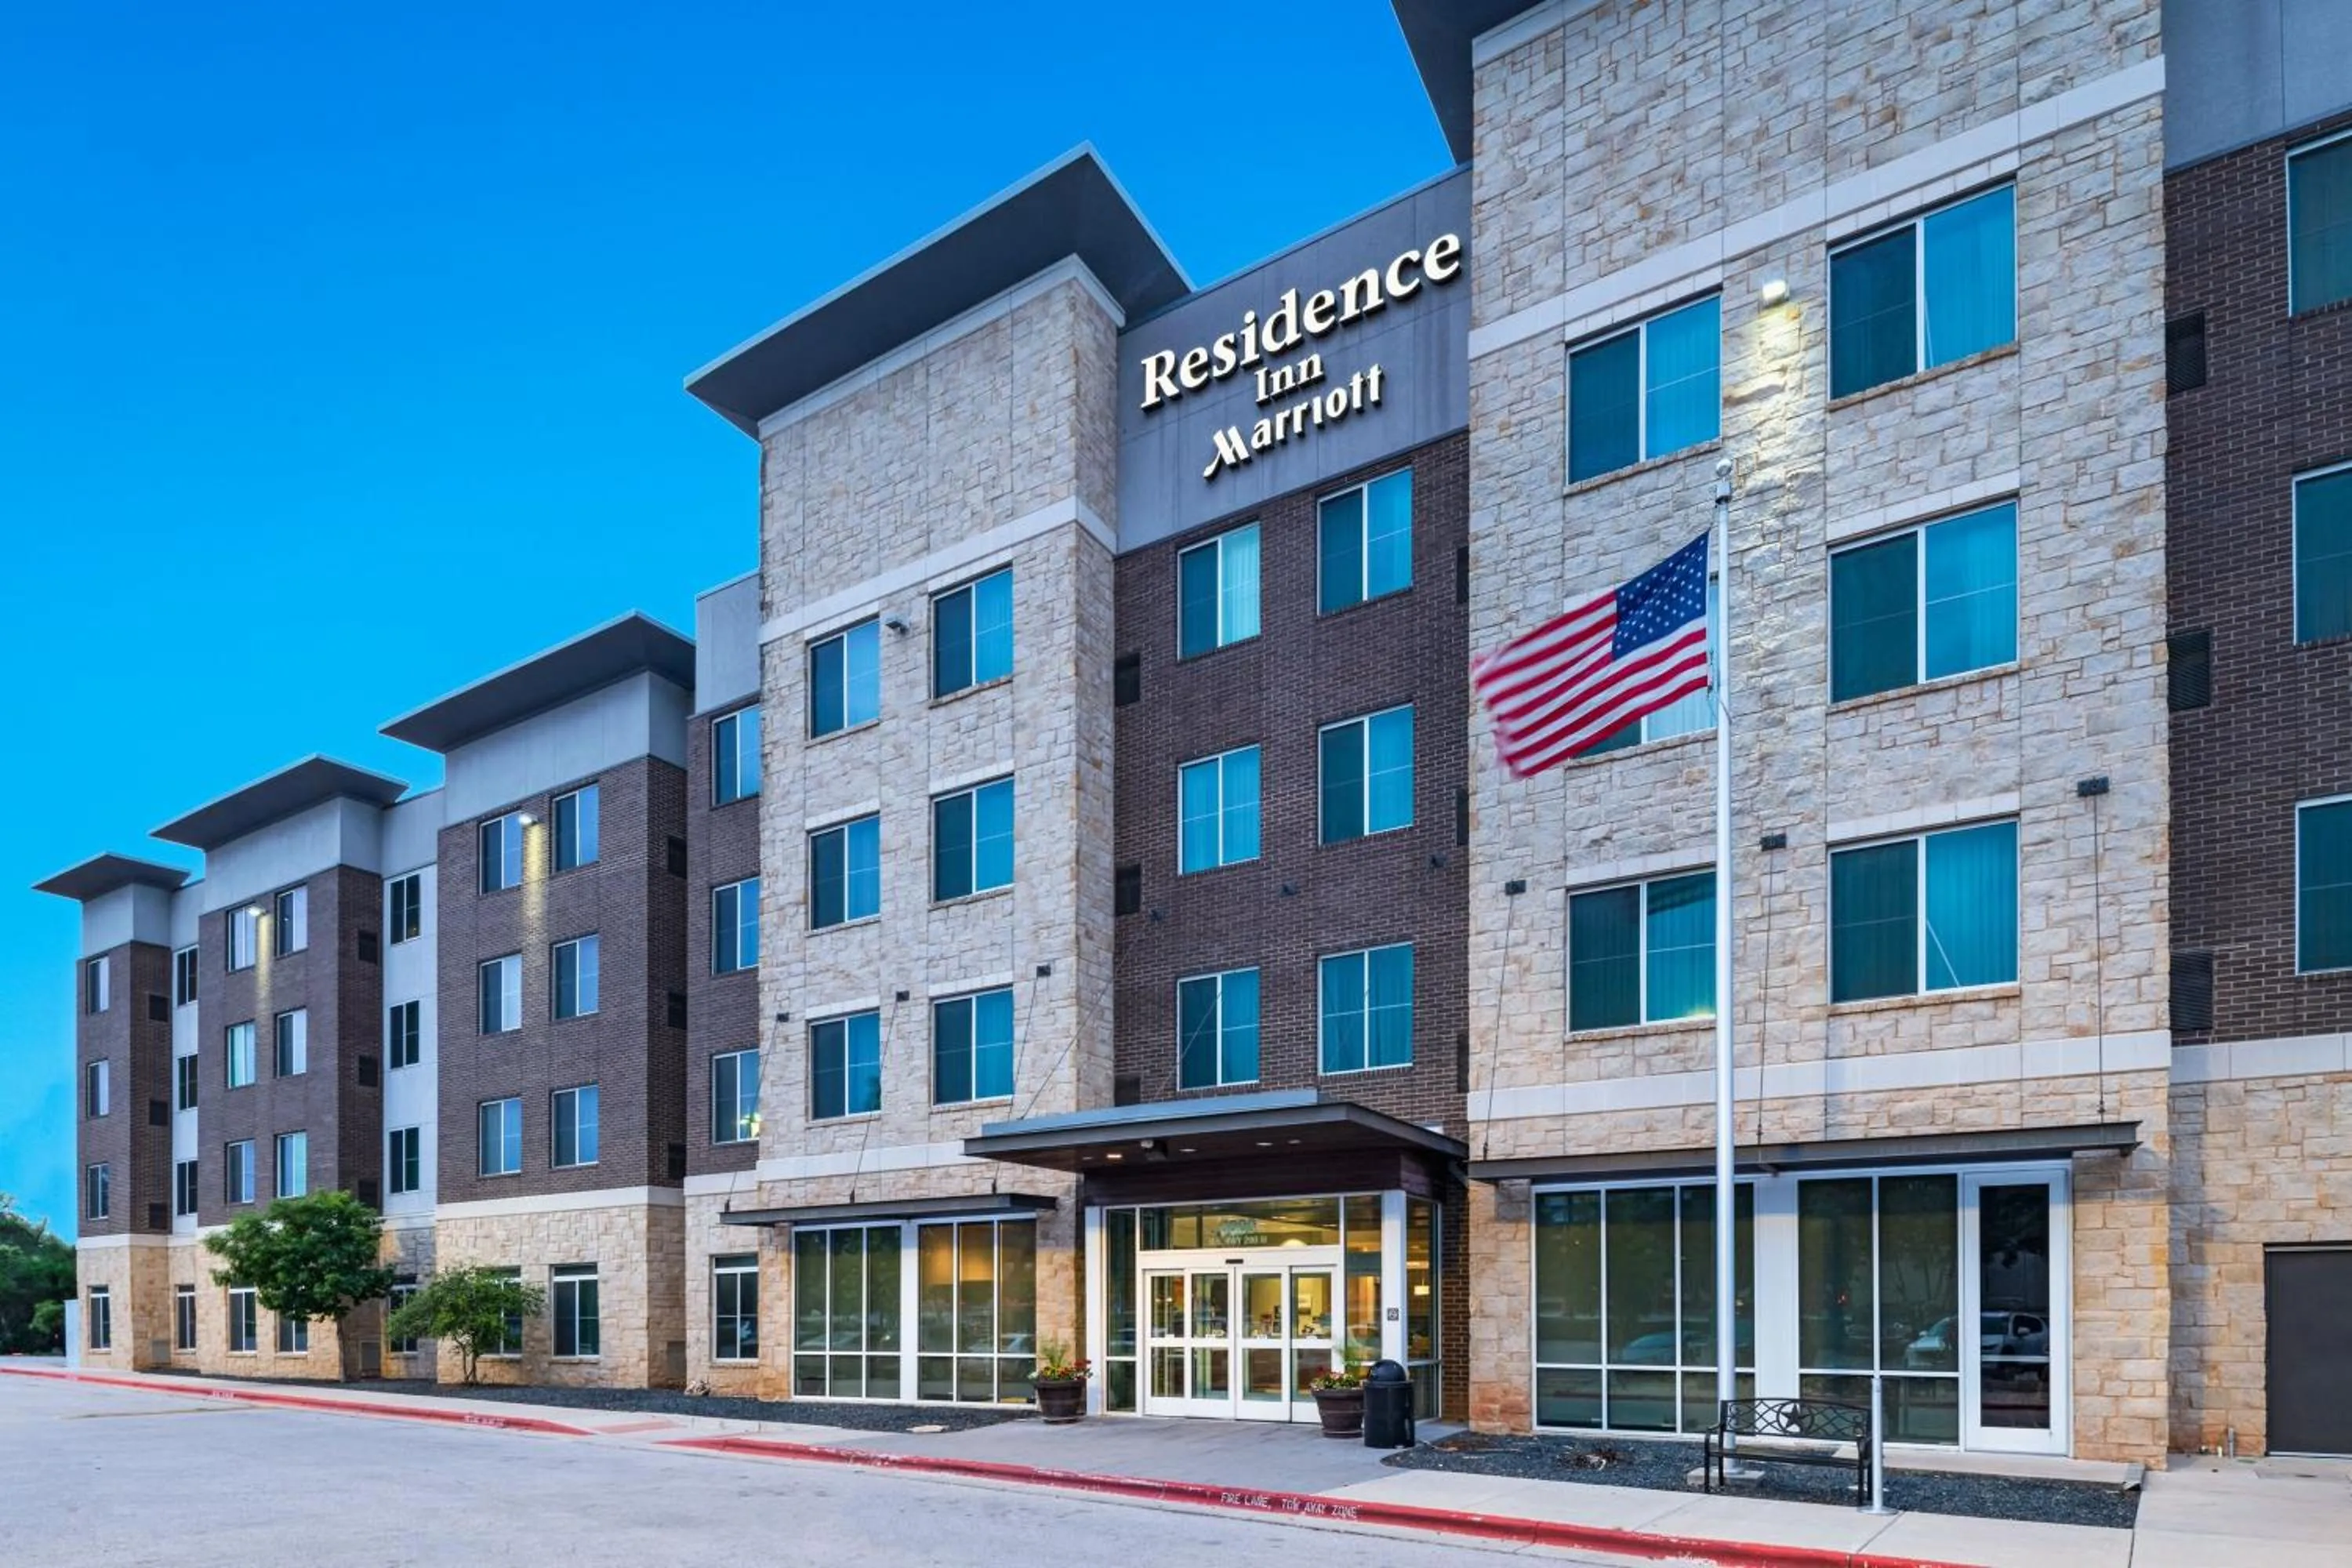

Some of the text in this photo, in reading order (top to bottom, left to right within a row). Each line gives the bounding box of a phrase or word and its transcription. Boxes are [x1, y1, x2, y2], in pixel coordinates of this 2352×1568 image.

[1141, 234, 1460, 409] Residence
[1254, 354, 1323, 403] Inn
[1203, 365, 1383, 477] Marriott
[1221, 1492, 1240, 1505] FIRE
[1282, 1498, 1301, 1511] TOW
[1305, 1500, 1326, 1514] AWAY
